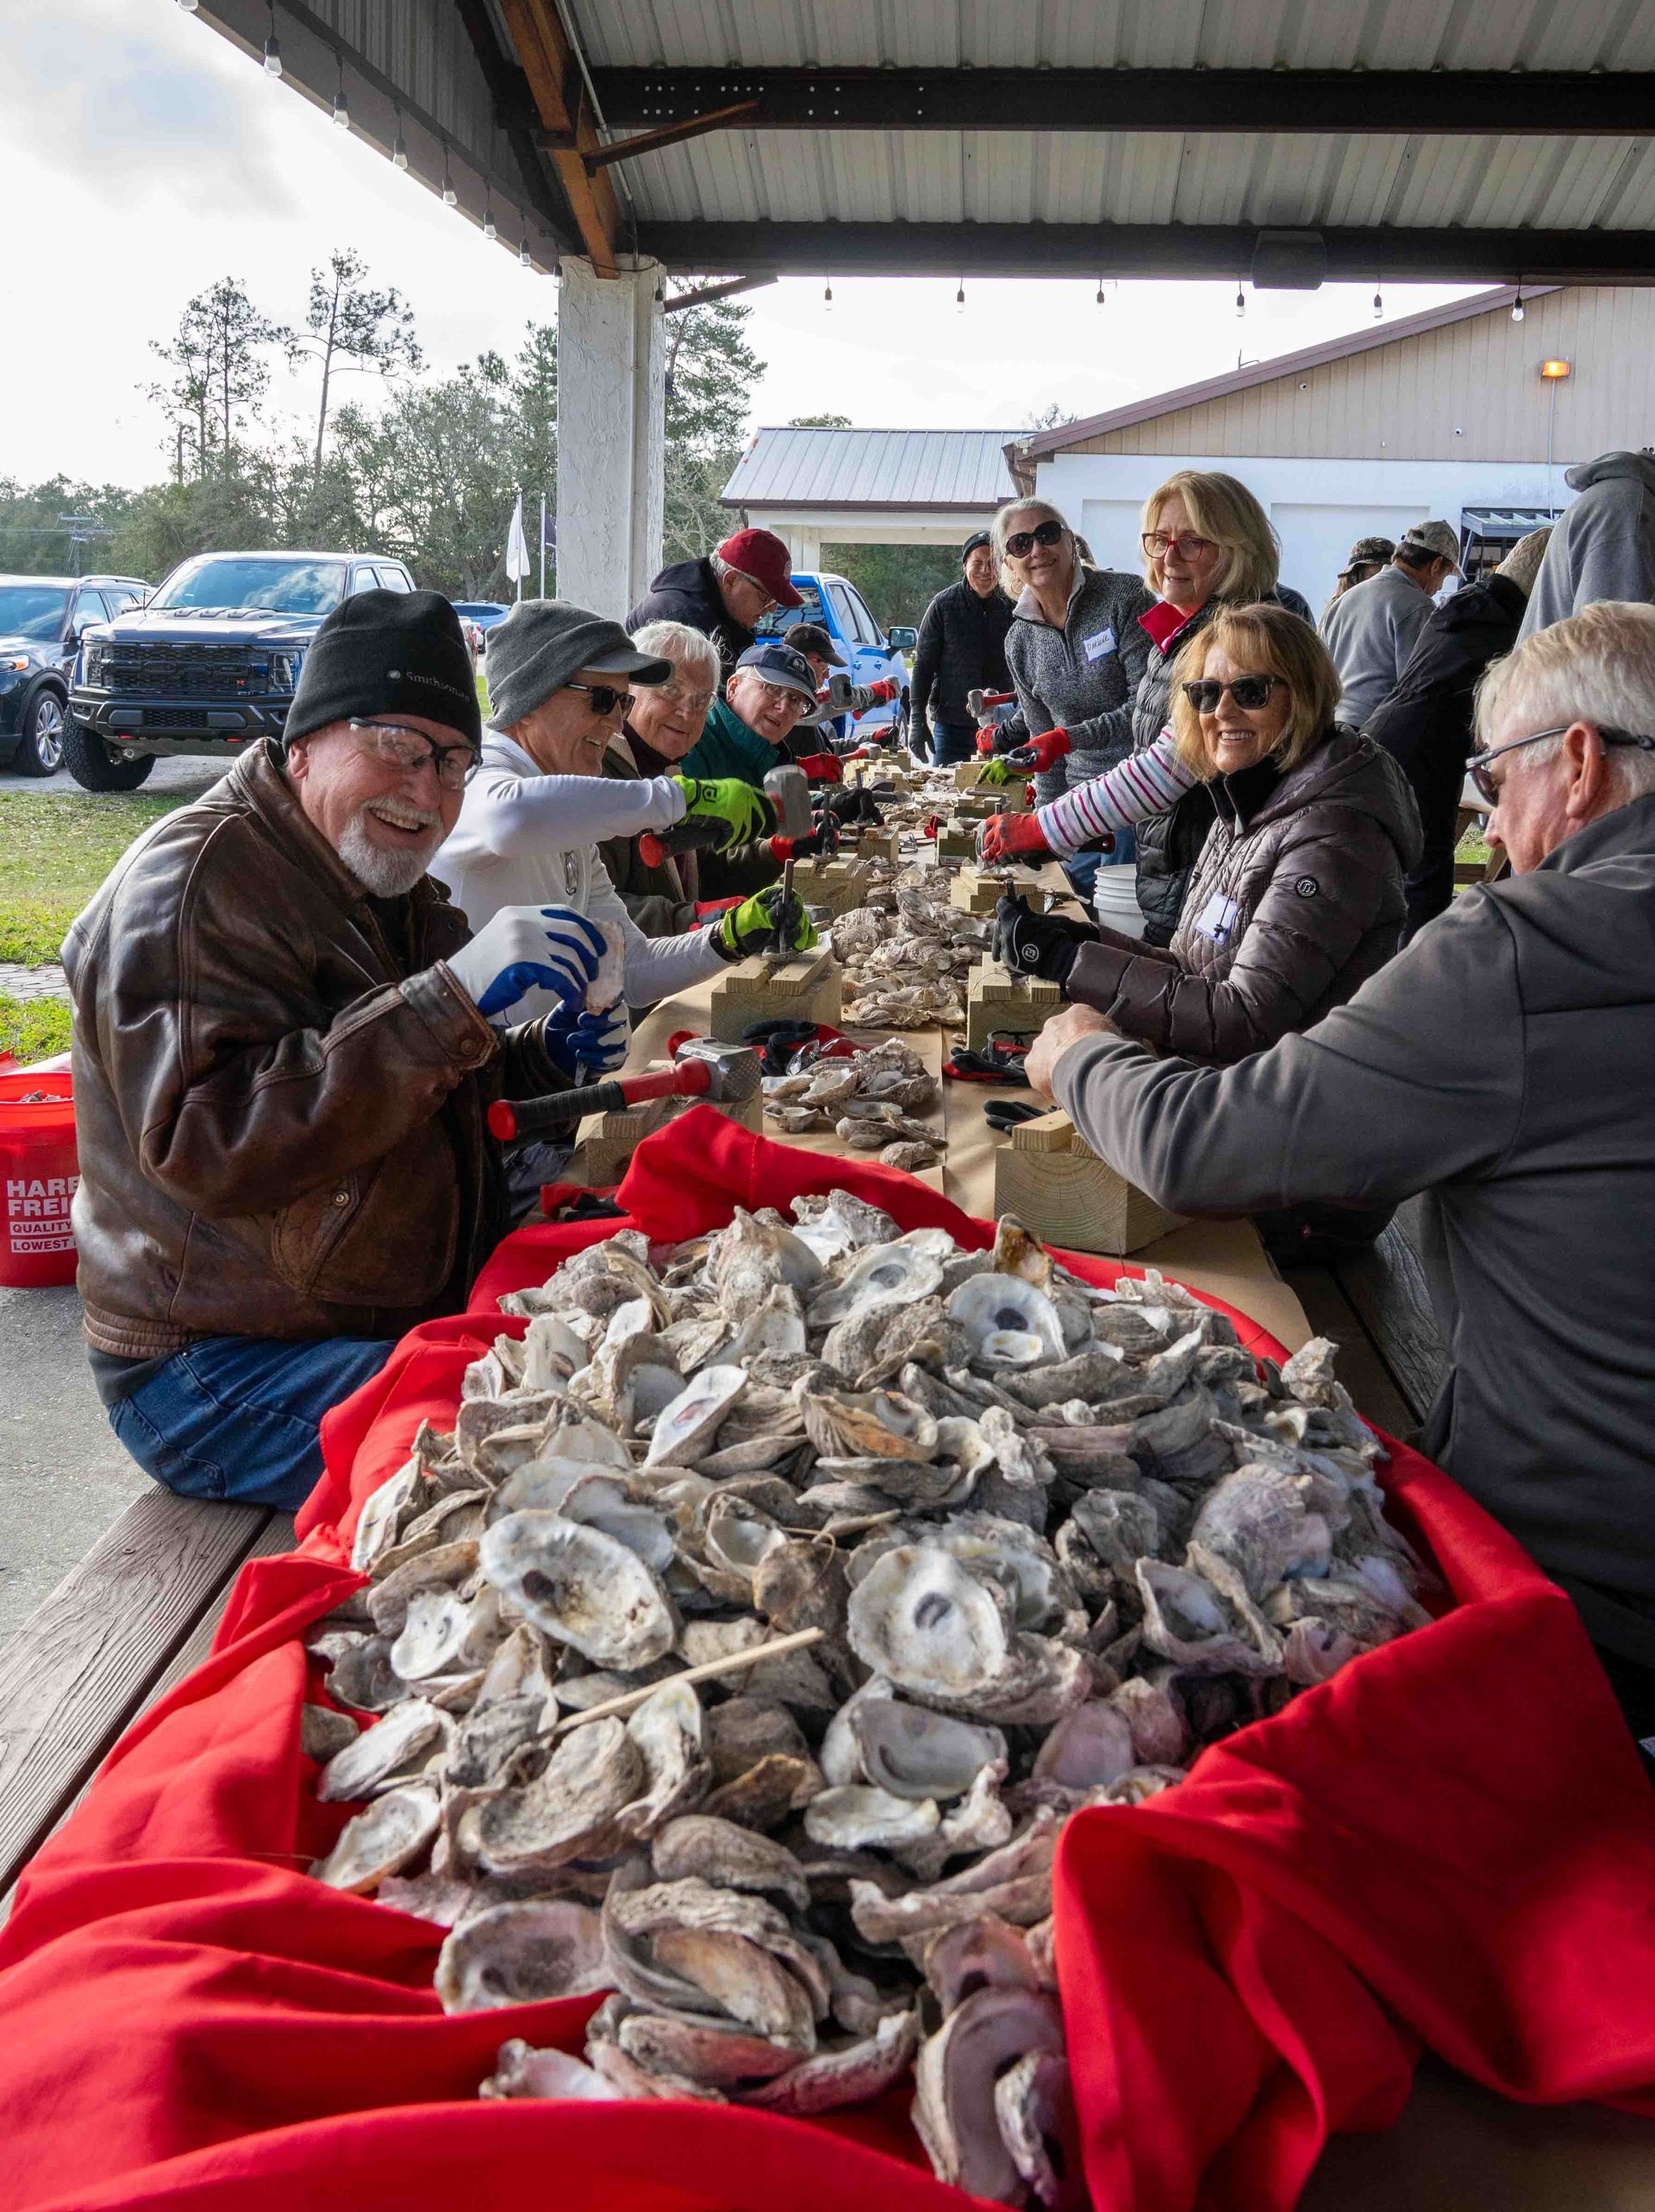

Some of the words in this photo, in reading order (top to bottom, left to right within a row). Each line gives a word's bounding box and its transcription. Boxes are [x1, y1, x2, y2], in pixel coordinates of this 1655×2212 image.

[8, 1197, 71, 1216] FREI
[12, 1221, 72, 1234] QUALITY
[13, 1239, 69, 1251] LOWEST
